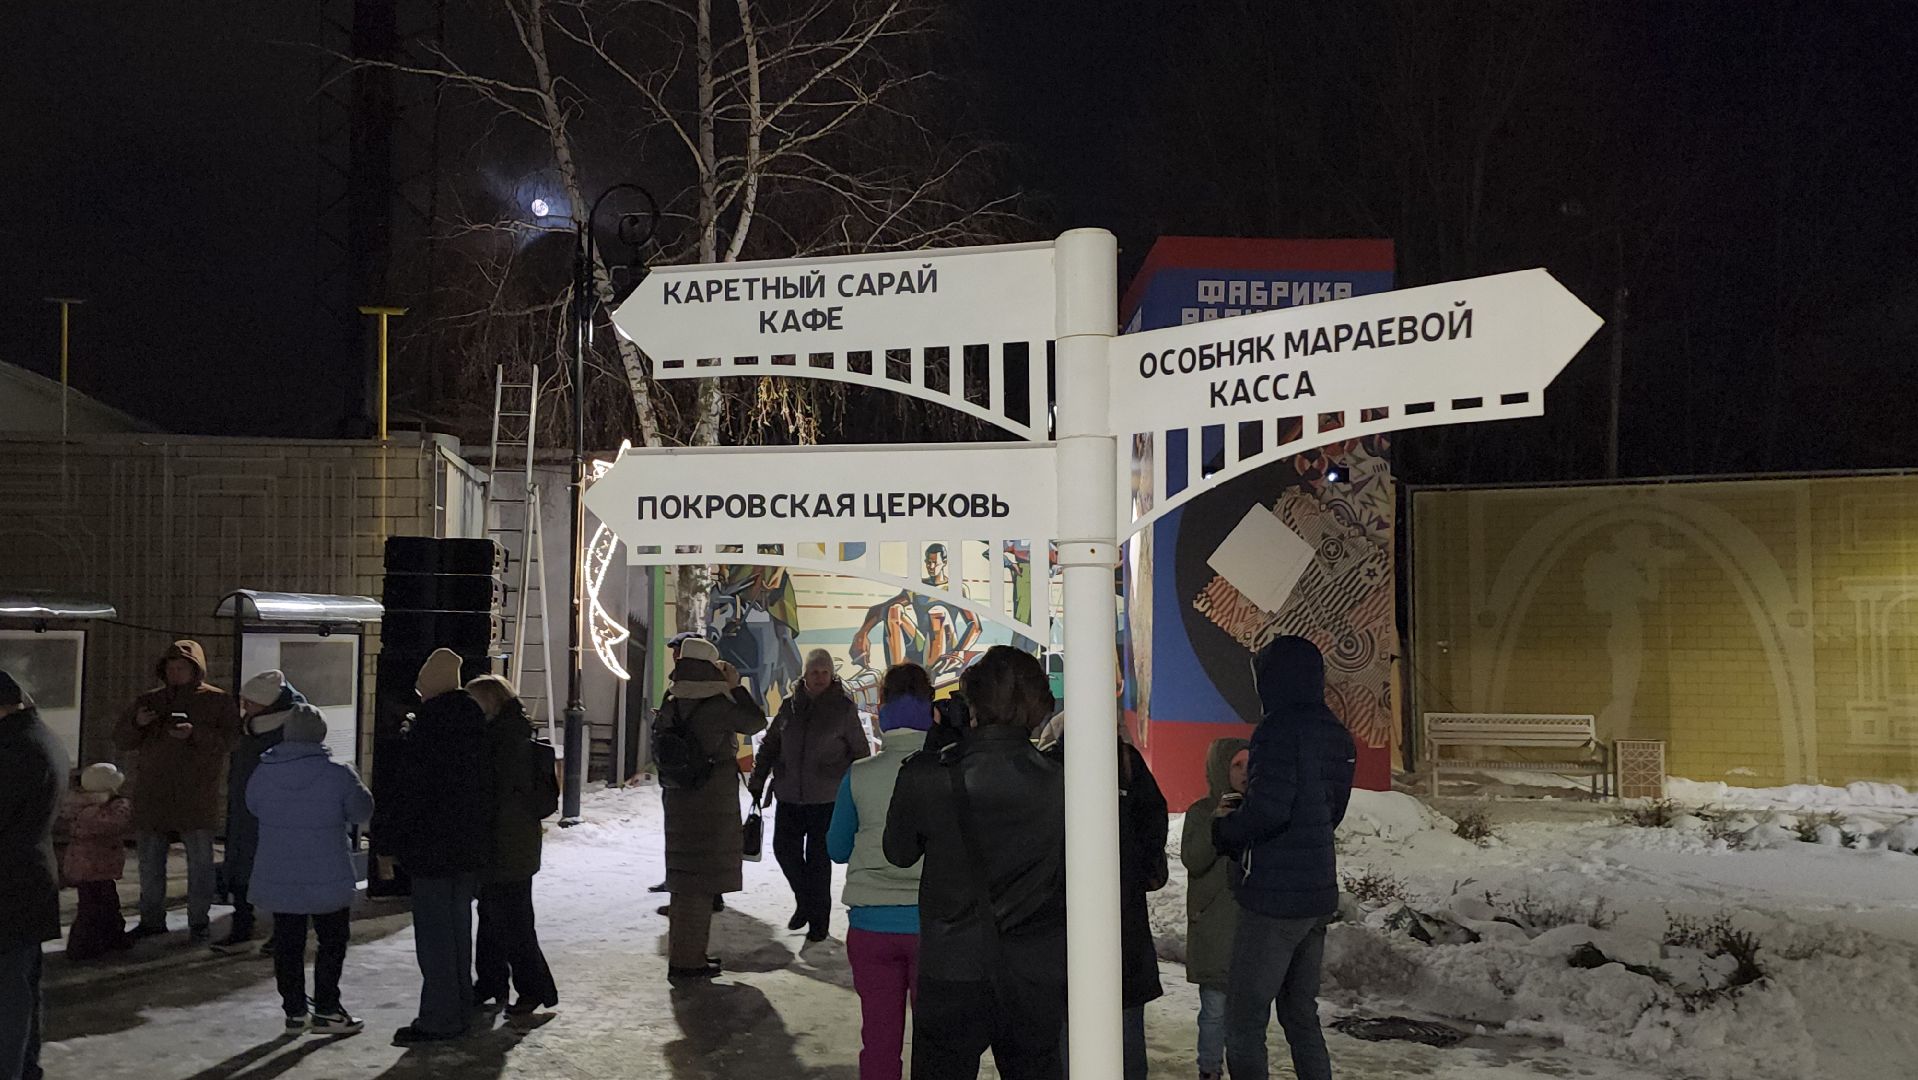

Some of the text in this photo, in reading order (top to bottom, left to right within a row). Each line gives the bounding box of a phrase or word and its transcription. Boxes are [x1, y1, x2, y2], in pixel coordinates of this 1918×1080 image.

[664, 263, 937, 304] КАРЕТНЫЙ САРАЙ
[760, 306, 843, 333] КАФЕ
[1140, 301, 1472, 378] ОСОБНЯК МАРАЕВОЙ
[1211, 371, 1316, 408] КАССА
[638, 493, 1009, 523] ПОКРОВСКАЯ ЦЕРКОВЬ
